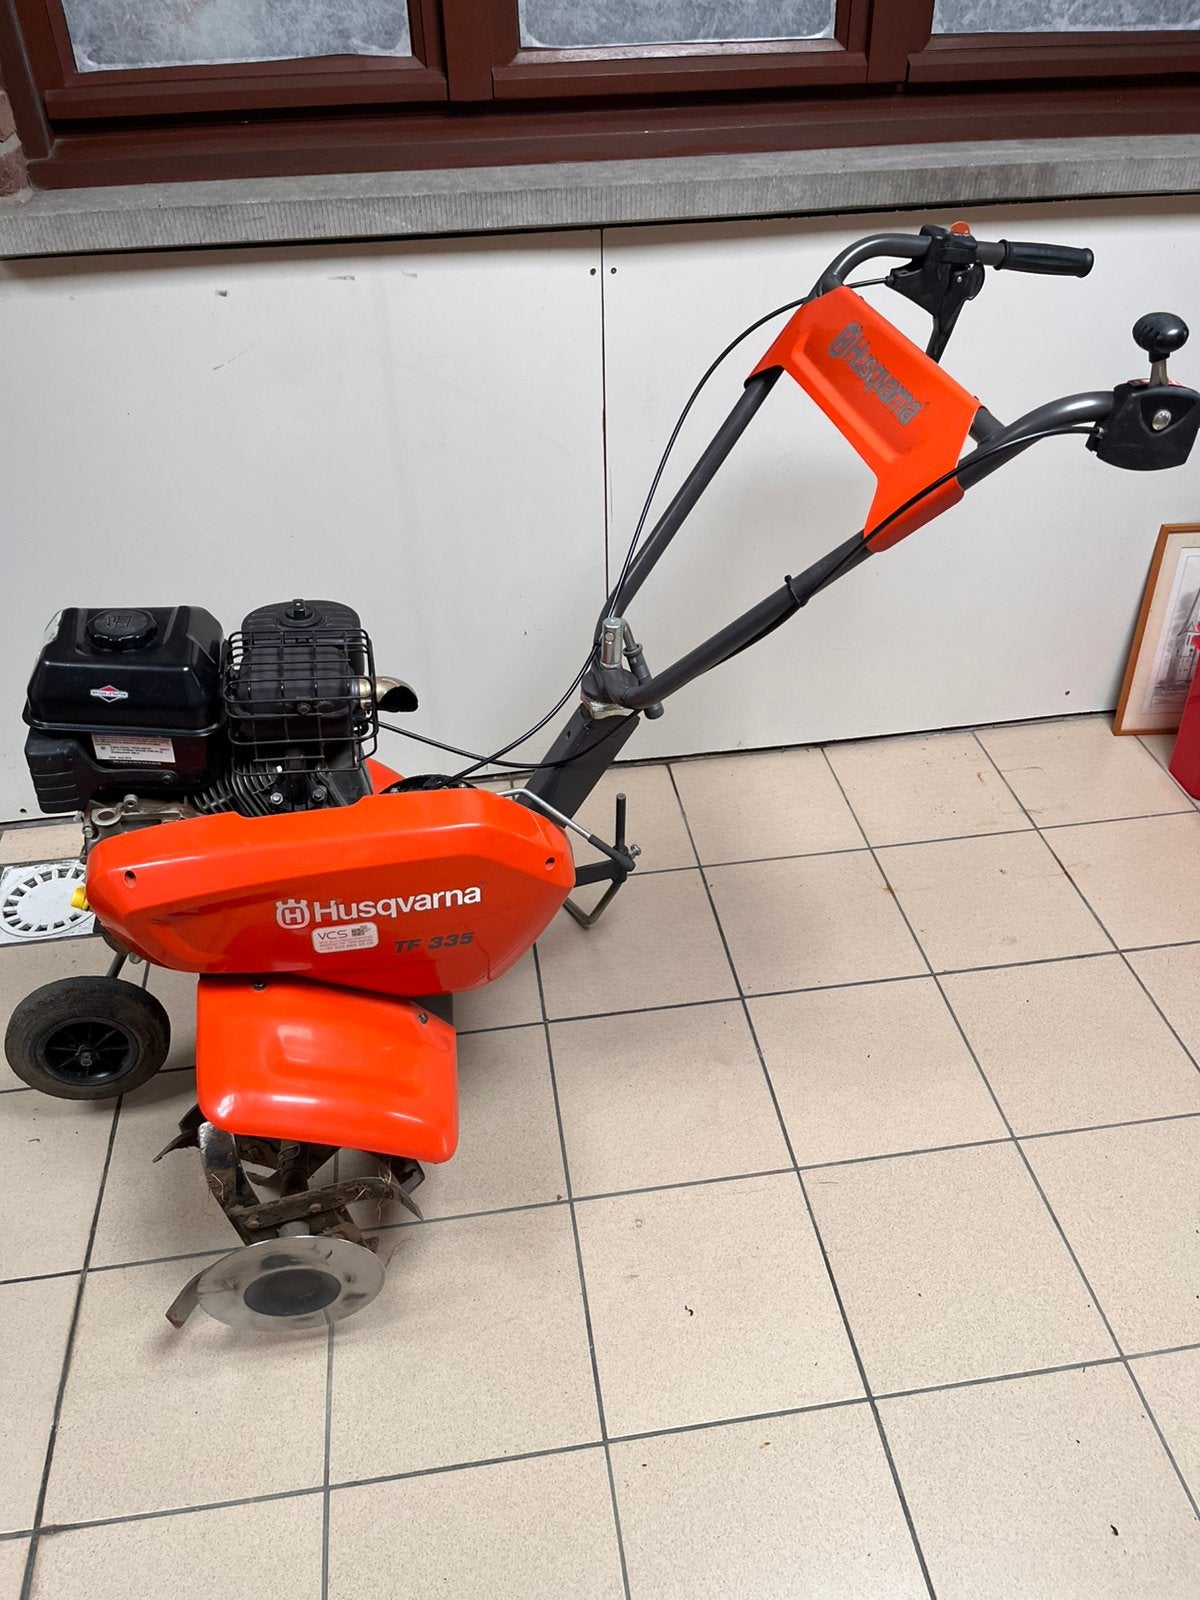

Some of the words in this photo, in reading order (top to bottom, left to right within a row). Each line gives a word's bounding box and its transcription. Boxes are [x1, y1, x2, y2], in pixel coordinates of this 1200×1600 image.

[841, 335, 923, 426] Husqvarna
[313, 886, 481, 923] Husqvarna
[317, 929, 348, 940] VCS
[395, 938, 421, 953] TF
[428, 931, 474, 950] 335
